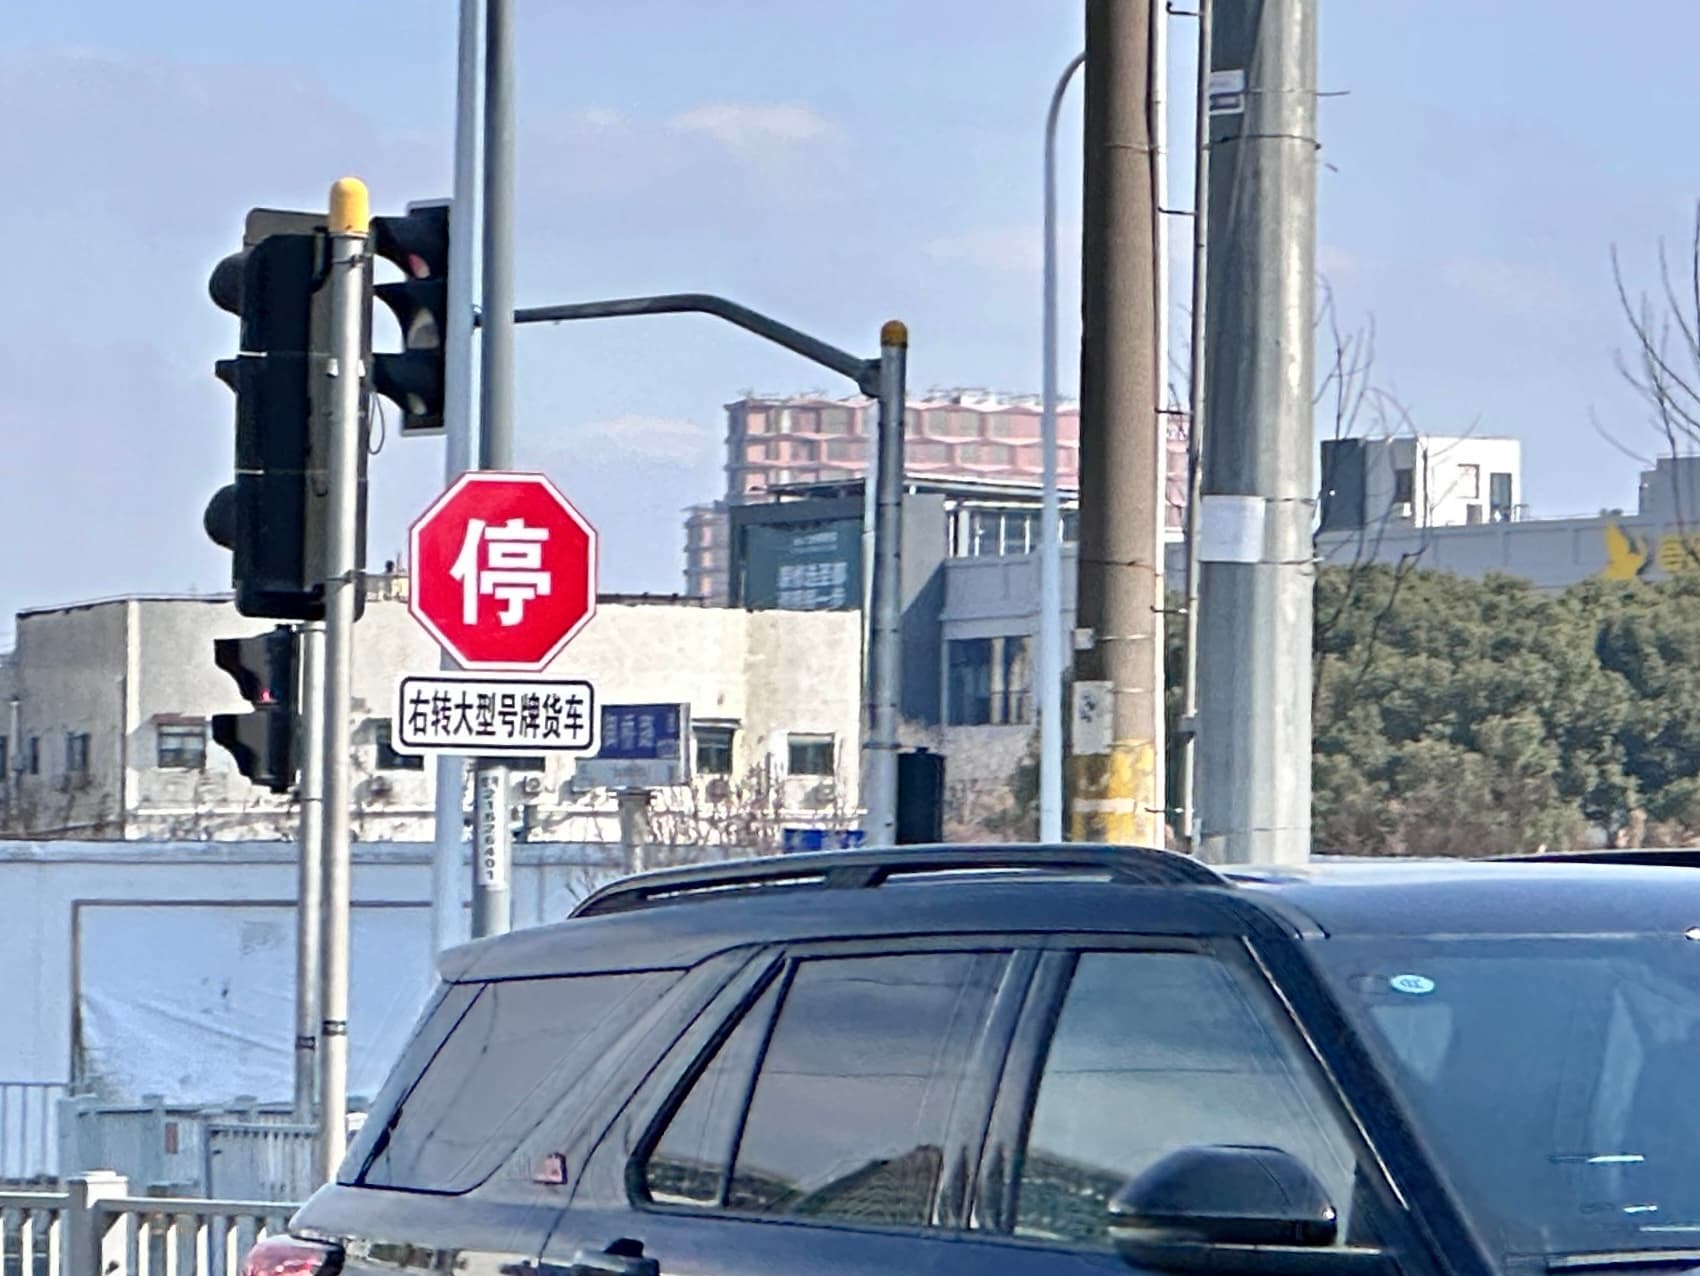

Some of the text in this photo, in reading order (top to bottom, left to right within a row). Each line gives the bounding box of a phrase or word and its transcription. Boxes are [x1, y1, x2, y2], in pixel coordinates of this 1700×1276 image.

[450, 518, 551, 626] 停
[408, 689, 584, 739] 右转大型号牌货车
